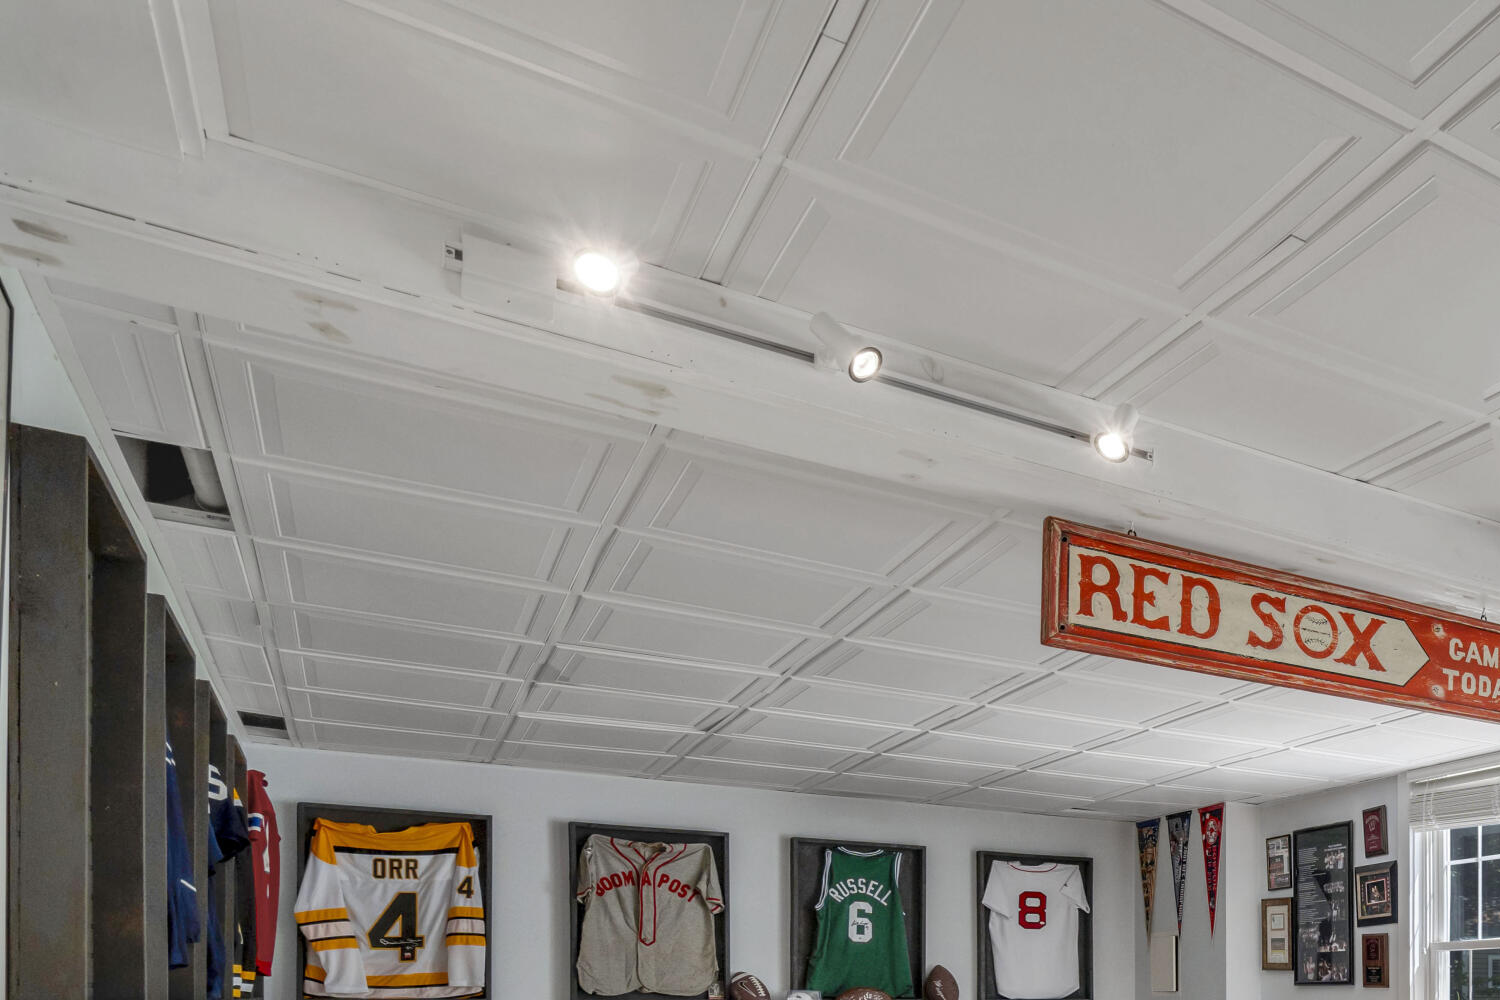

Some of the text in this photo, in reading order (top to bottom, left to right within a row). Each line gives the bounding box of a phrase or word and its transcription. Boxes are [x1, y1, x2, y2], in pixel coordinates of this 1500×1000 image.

[1077, 553, 1388, 672] RED SOX
[372, 857, 419, 880] ORR
[456, 875, 475, 899] 4
[657, 872, 702, 903] POST
[828, 878, 892, 906] RUSSELL
[366, 890, 426, 963] 4
[848, 901, 873, 943] 6
[1018, 890, 1047, 930] 8
